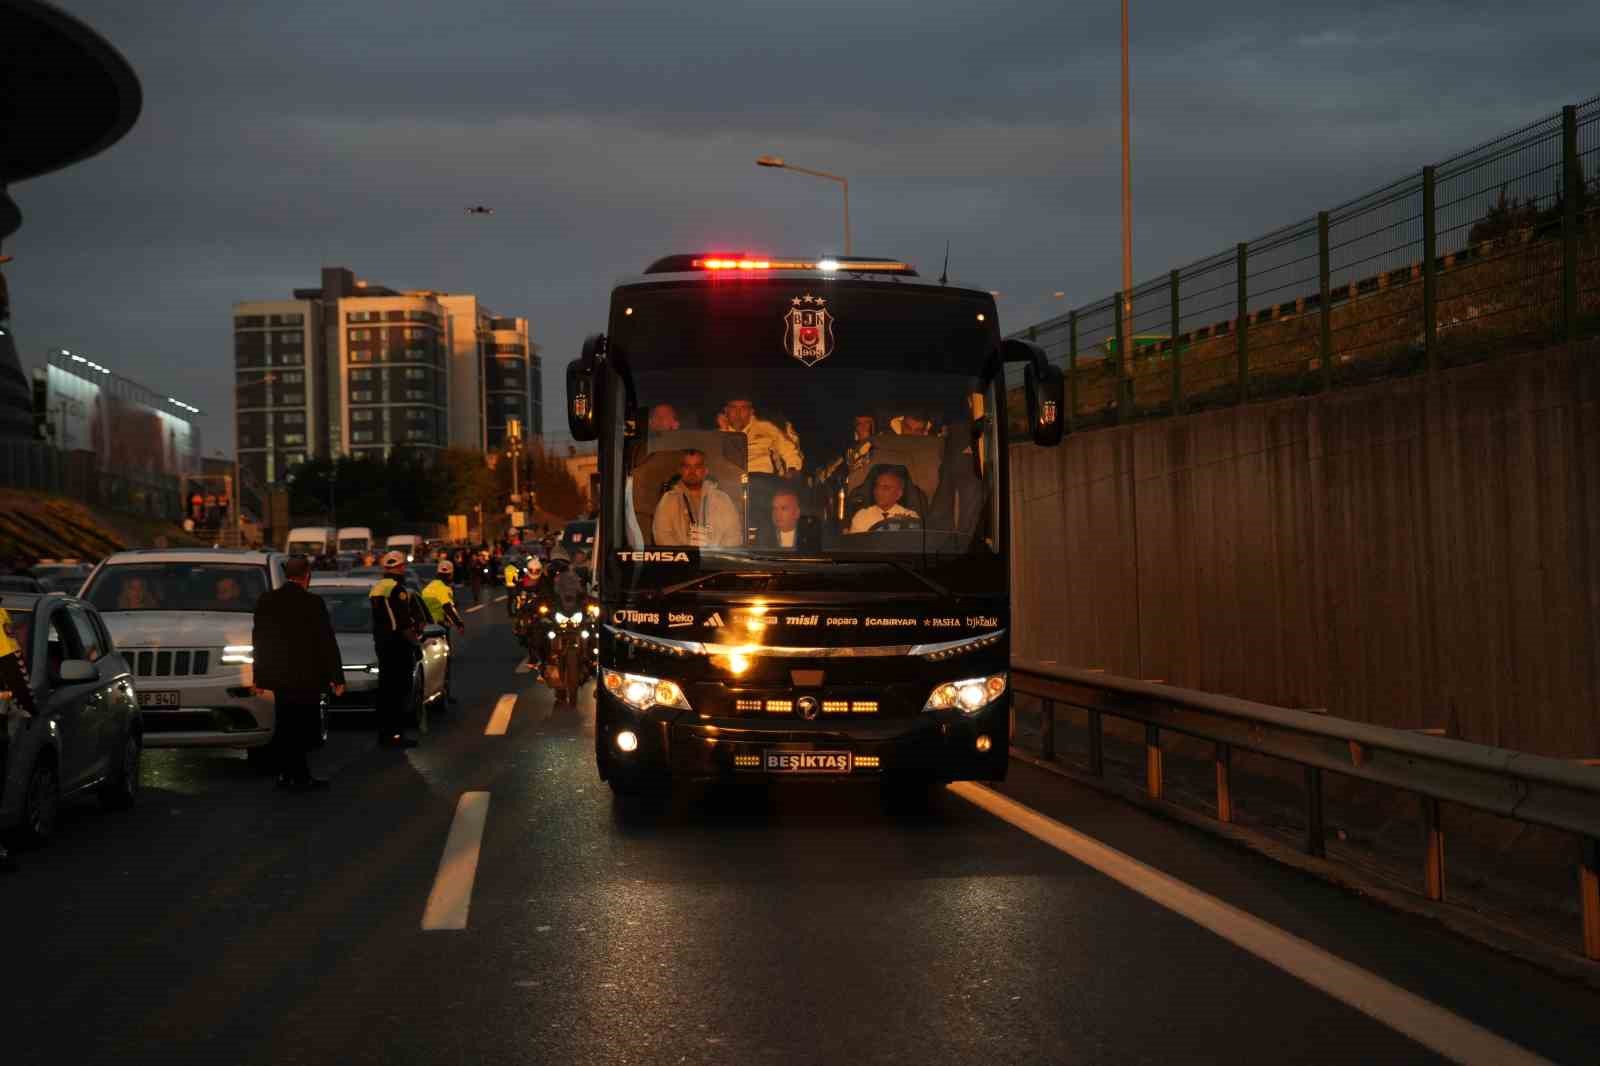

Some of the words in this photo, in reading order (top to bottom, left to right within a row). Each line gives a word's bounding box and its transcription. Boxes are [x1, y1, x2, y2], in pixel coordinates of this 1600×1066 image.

[616, 552, 690, 563] TEMSA
[626, 610, 660, 624] Tüpraş
[668, 612, 694, 623] beko
[933, 618, 961, 626] PASHA
[768, 752, 848, 770] BEŞİKTAŞ
